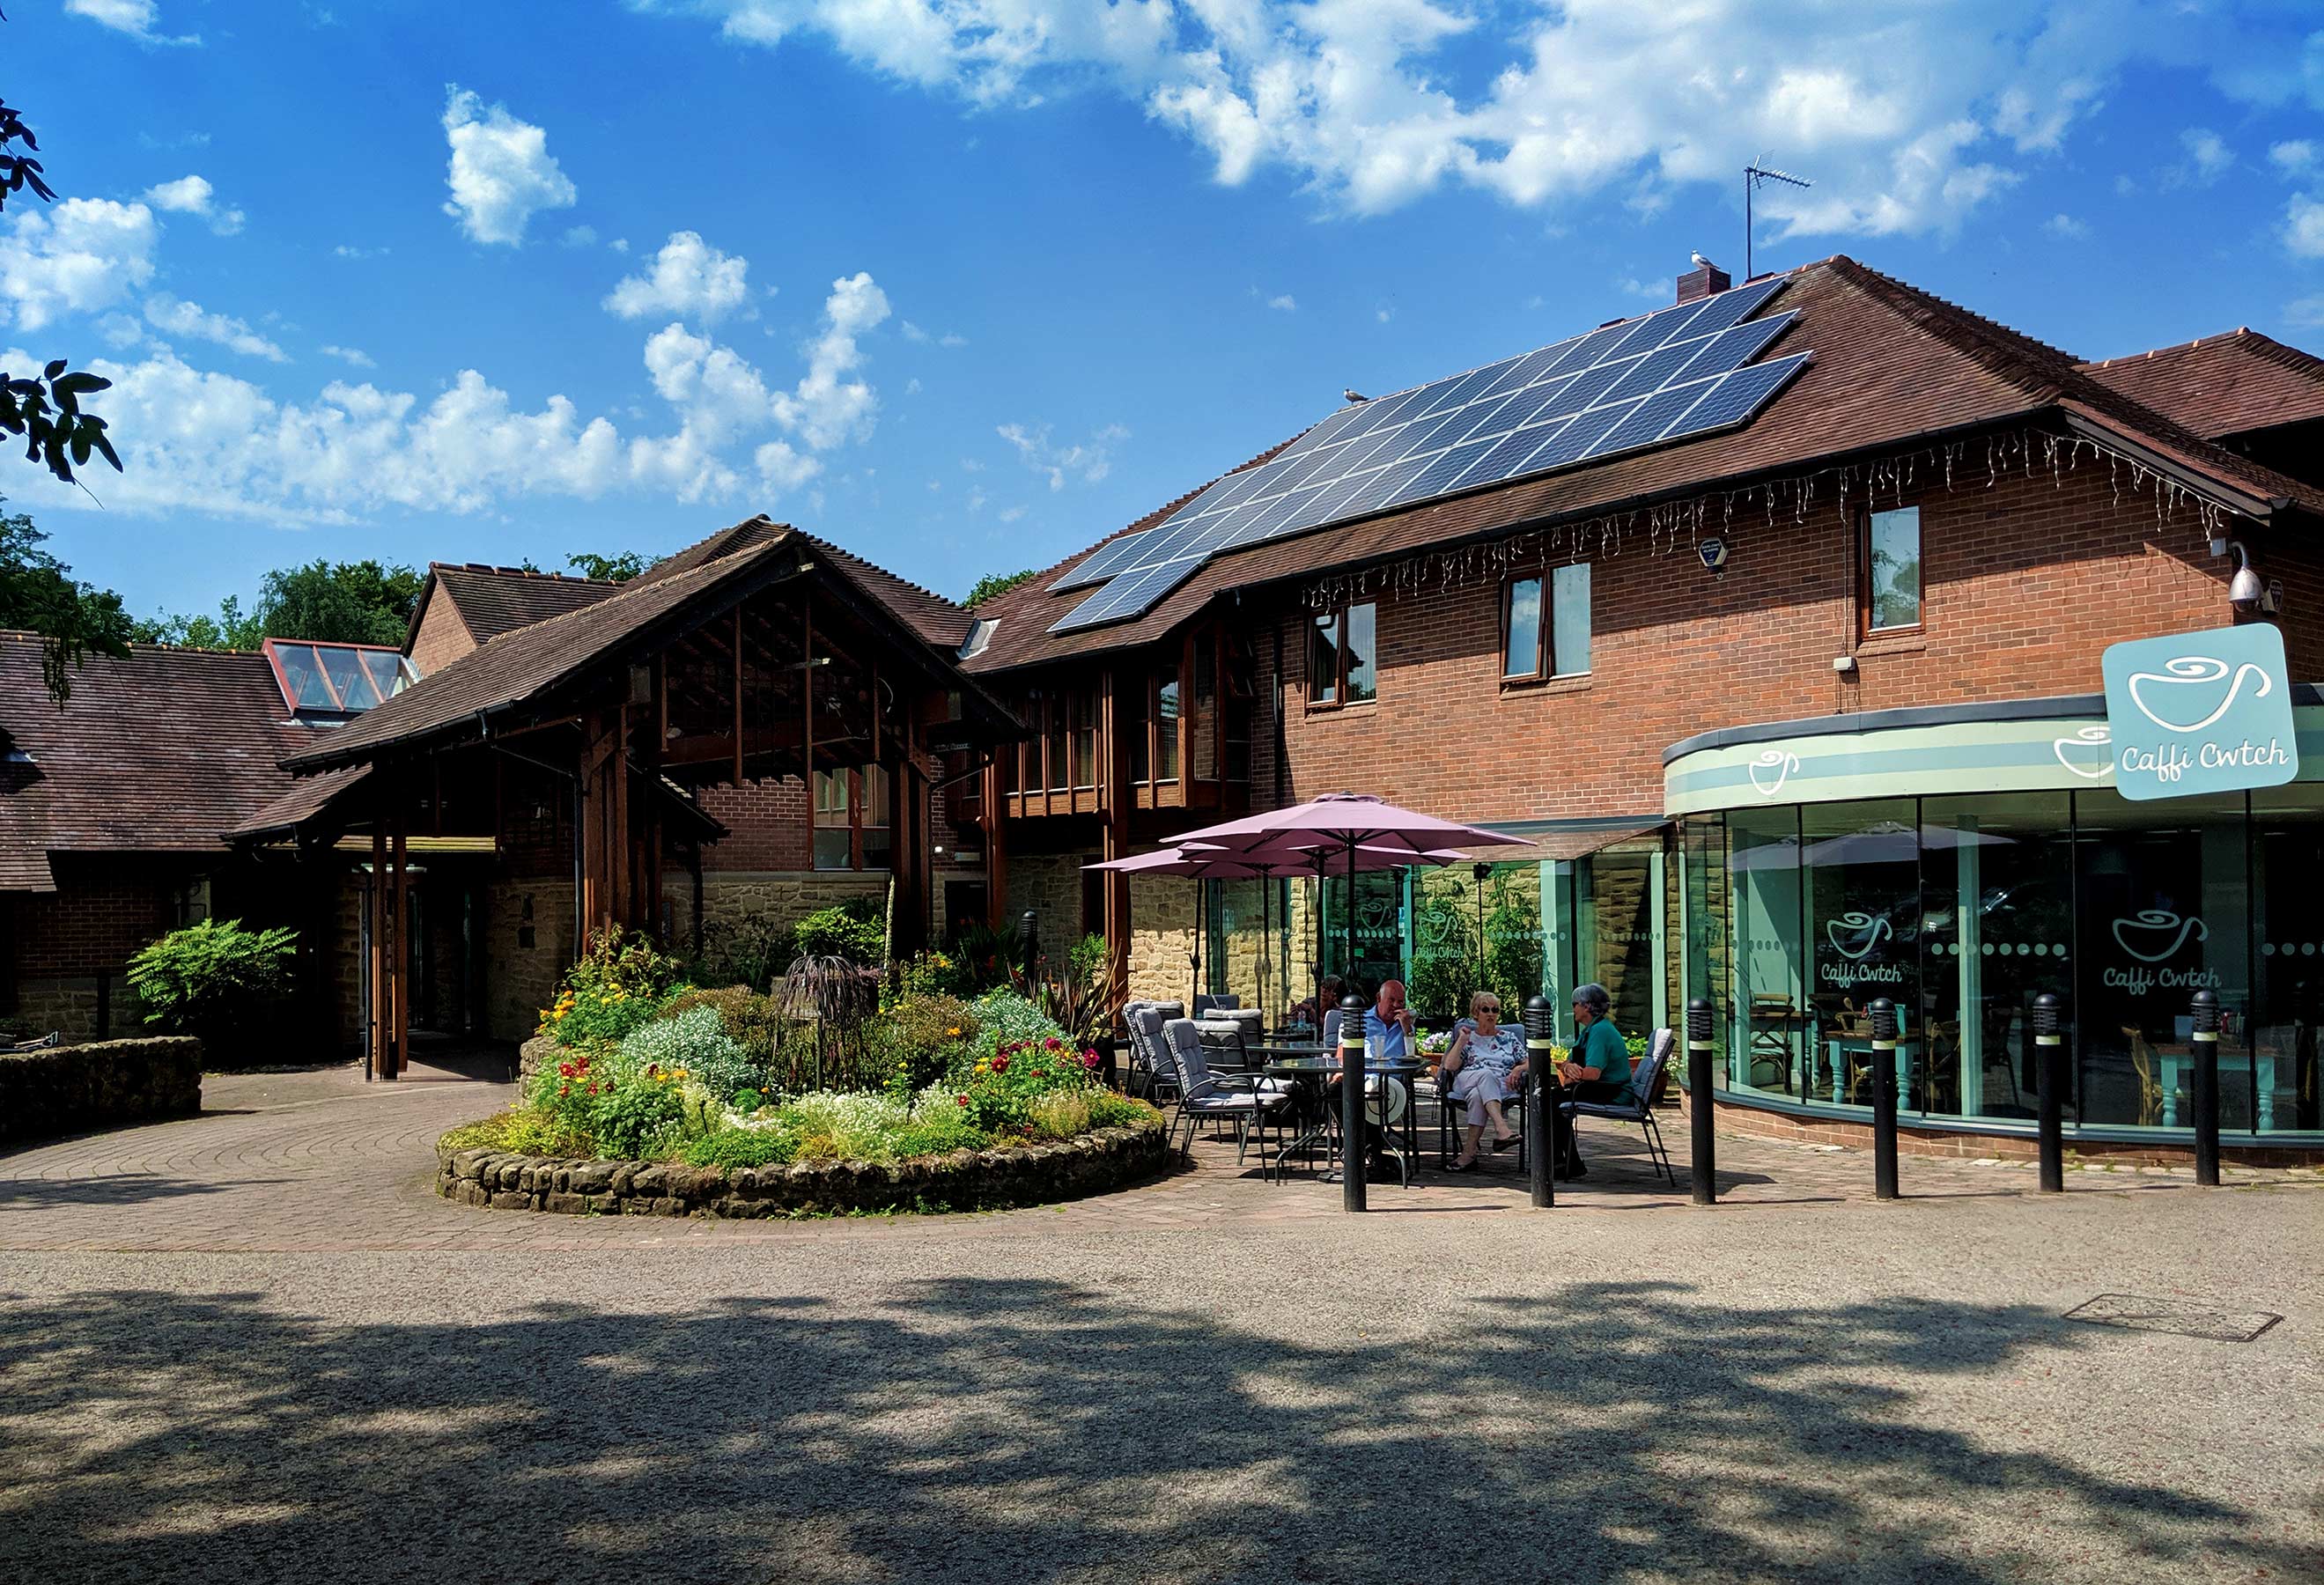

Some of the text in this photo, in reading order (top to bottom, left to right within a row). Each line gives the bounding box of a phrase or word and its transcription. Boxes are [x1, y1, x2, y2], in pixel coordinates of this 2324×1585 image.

[2121, 738, 2290, 782] Caffi Cwtch
[1821, 963, 1902, 988] Caffi Cwtch
[2104, 967, 2222, 995] Caffi Cwtch
